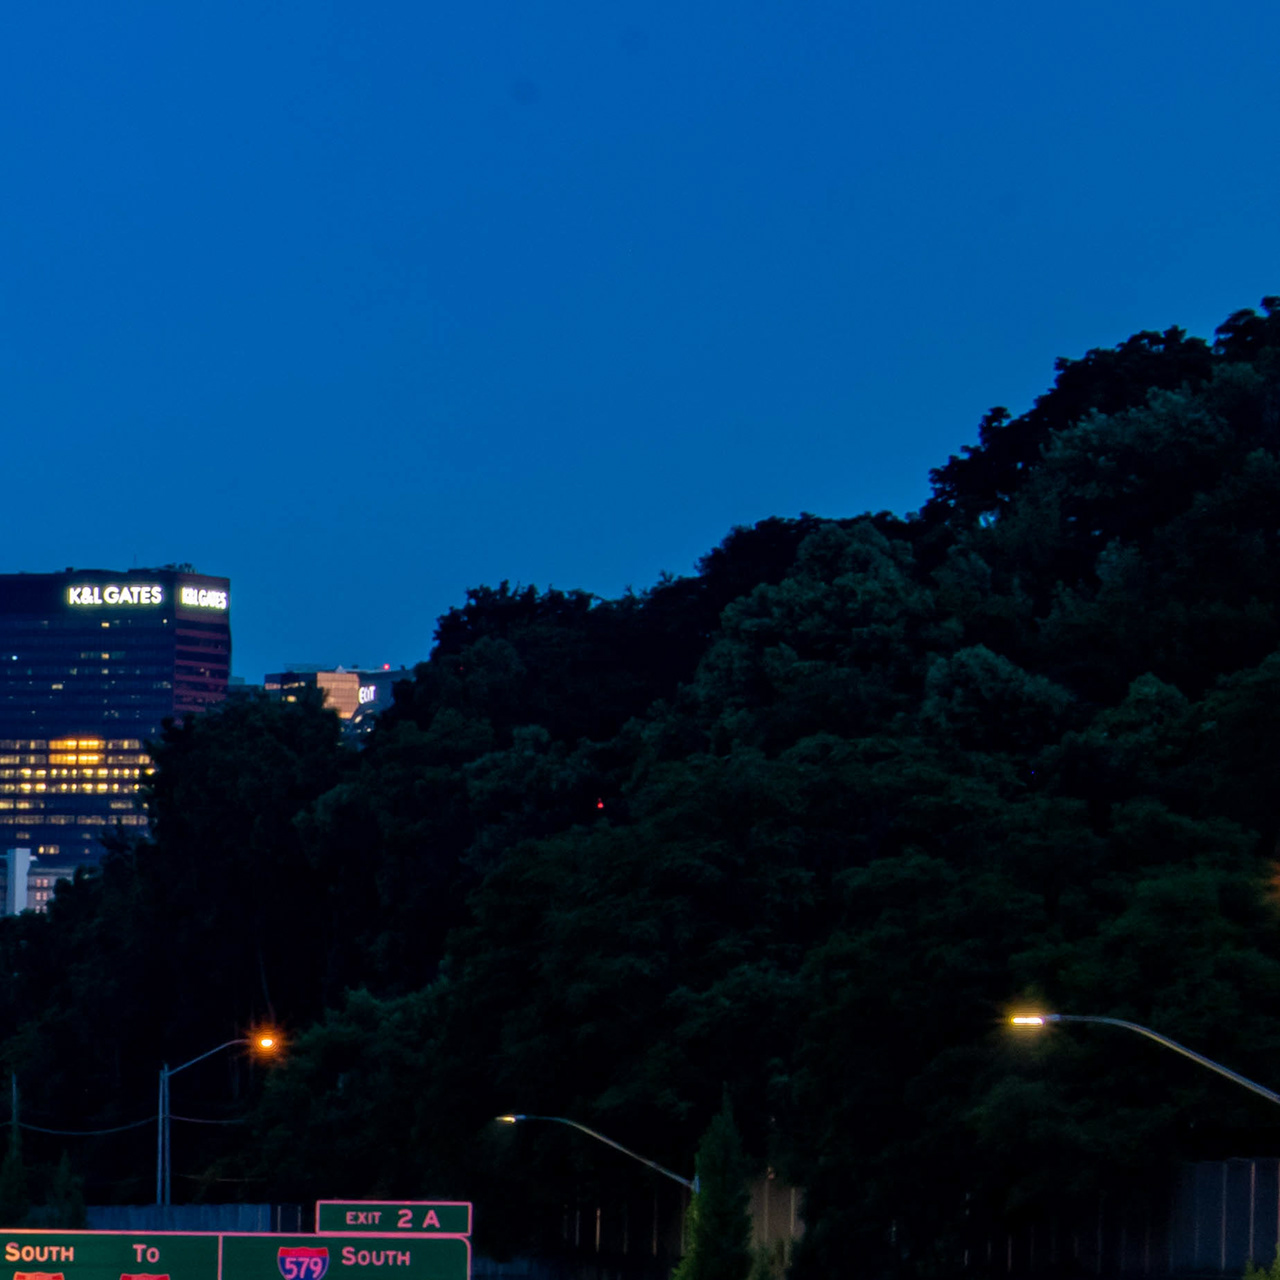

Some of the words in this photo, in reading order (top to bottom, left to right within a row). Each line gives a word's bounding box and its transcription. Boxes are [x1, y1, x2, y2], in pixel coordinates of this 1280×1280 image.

[68, 587, 102, 604] K&L
[104, 587, 162, 604] GATES
[199, 589, 227, 609] GATES
[346, 1211, 381, 1226] EXIT
[4, 1243, 74, 1263] SOUTH
[284, 1257, 323, 1280] 579
[341, 1247, 411, 1267] SOUTH
